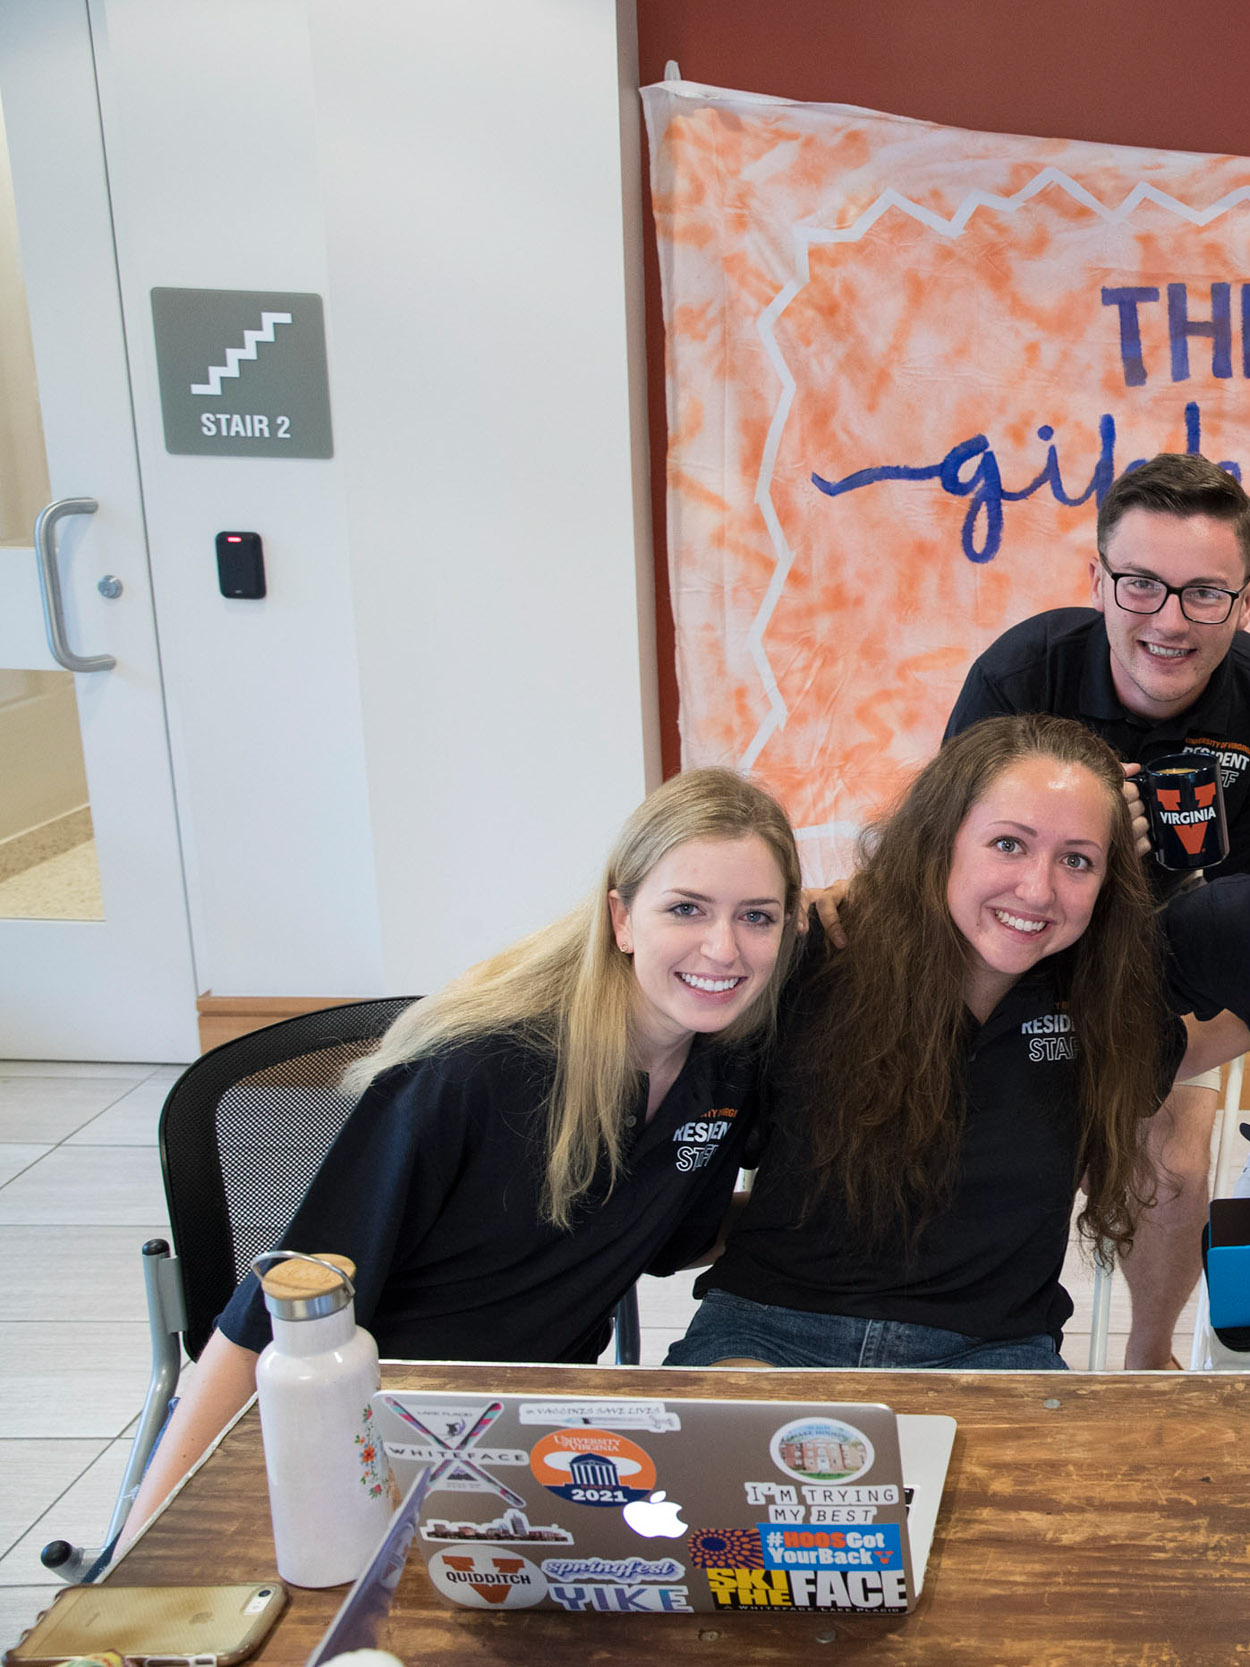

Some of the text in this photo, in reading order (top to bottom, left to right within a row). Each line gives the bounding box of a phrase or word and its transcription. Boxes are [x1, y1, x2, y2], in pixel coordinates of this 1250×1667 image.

[201, 413, 291, 438] STAIR 2
[1160, 807, 1217, 825] VIRGINIA
[389, 1446, 528, 1462] WHITEFACE
[571, 1488, 628, 1503] 2021
[751, 1486, 894, 1502] I'M TRYING
[775, 1509, 872, 1522] MY BEST
[766, 1531, 885, 1549] #HOOSGot
[768, 1548, 873, 1565] YourBack
[446, 1571, 532, 1586] QUIDDITCH
[546, 1559, 677, 1581] springfest
[706, 1568, 908, 1608] SKI FACE
[710, 1588, 792, 1606] THE
